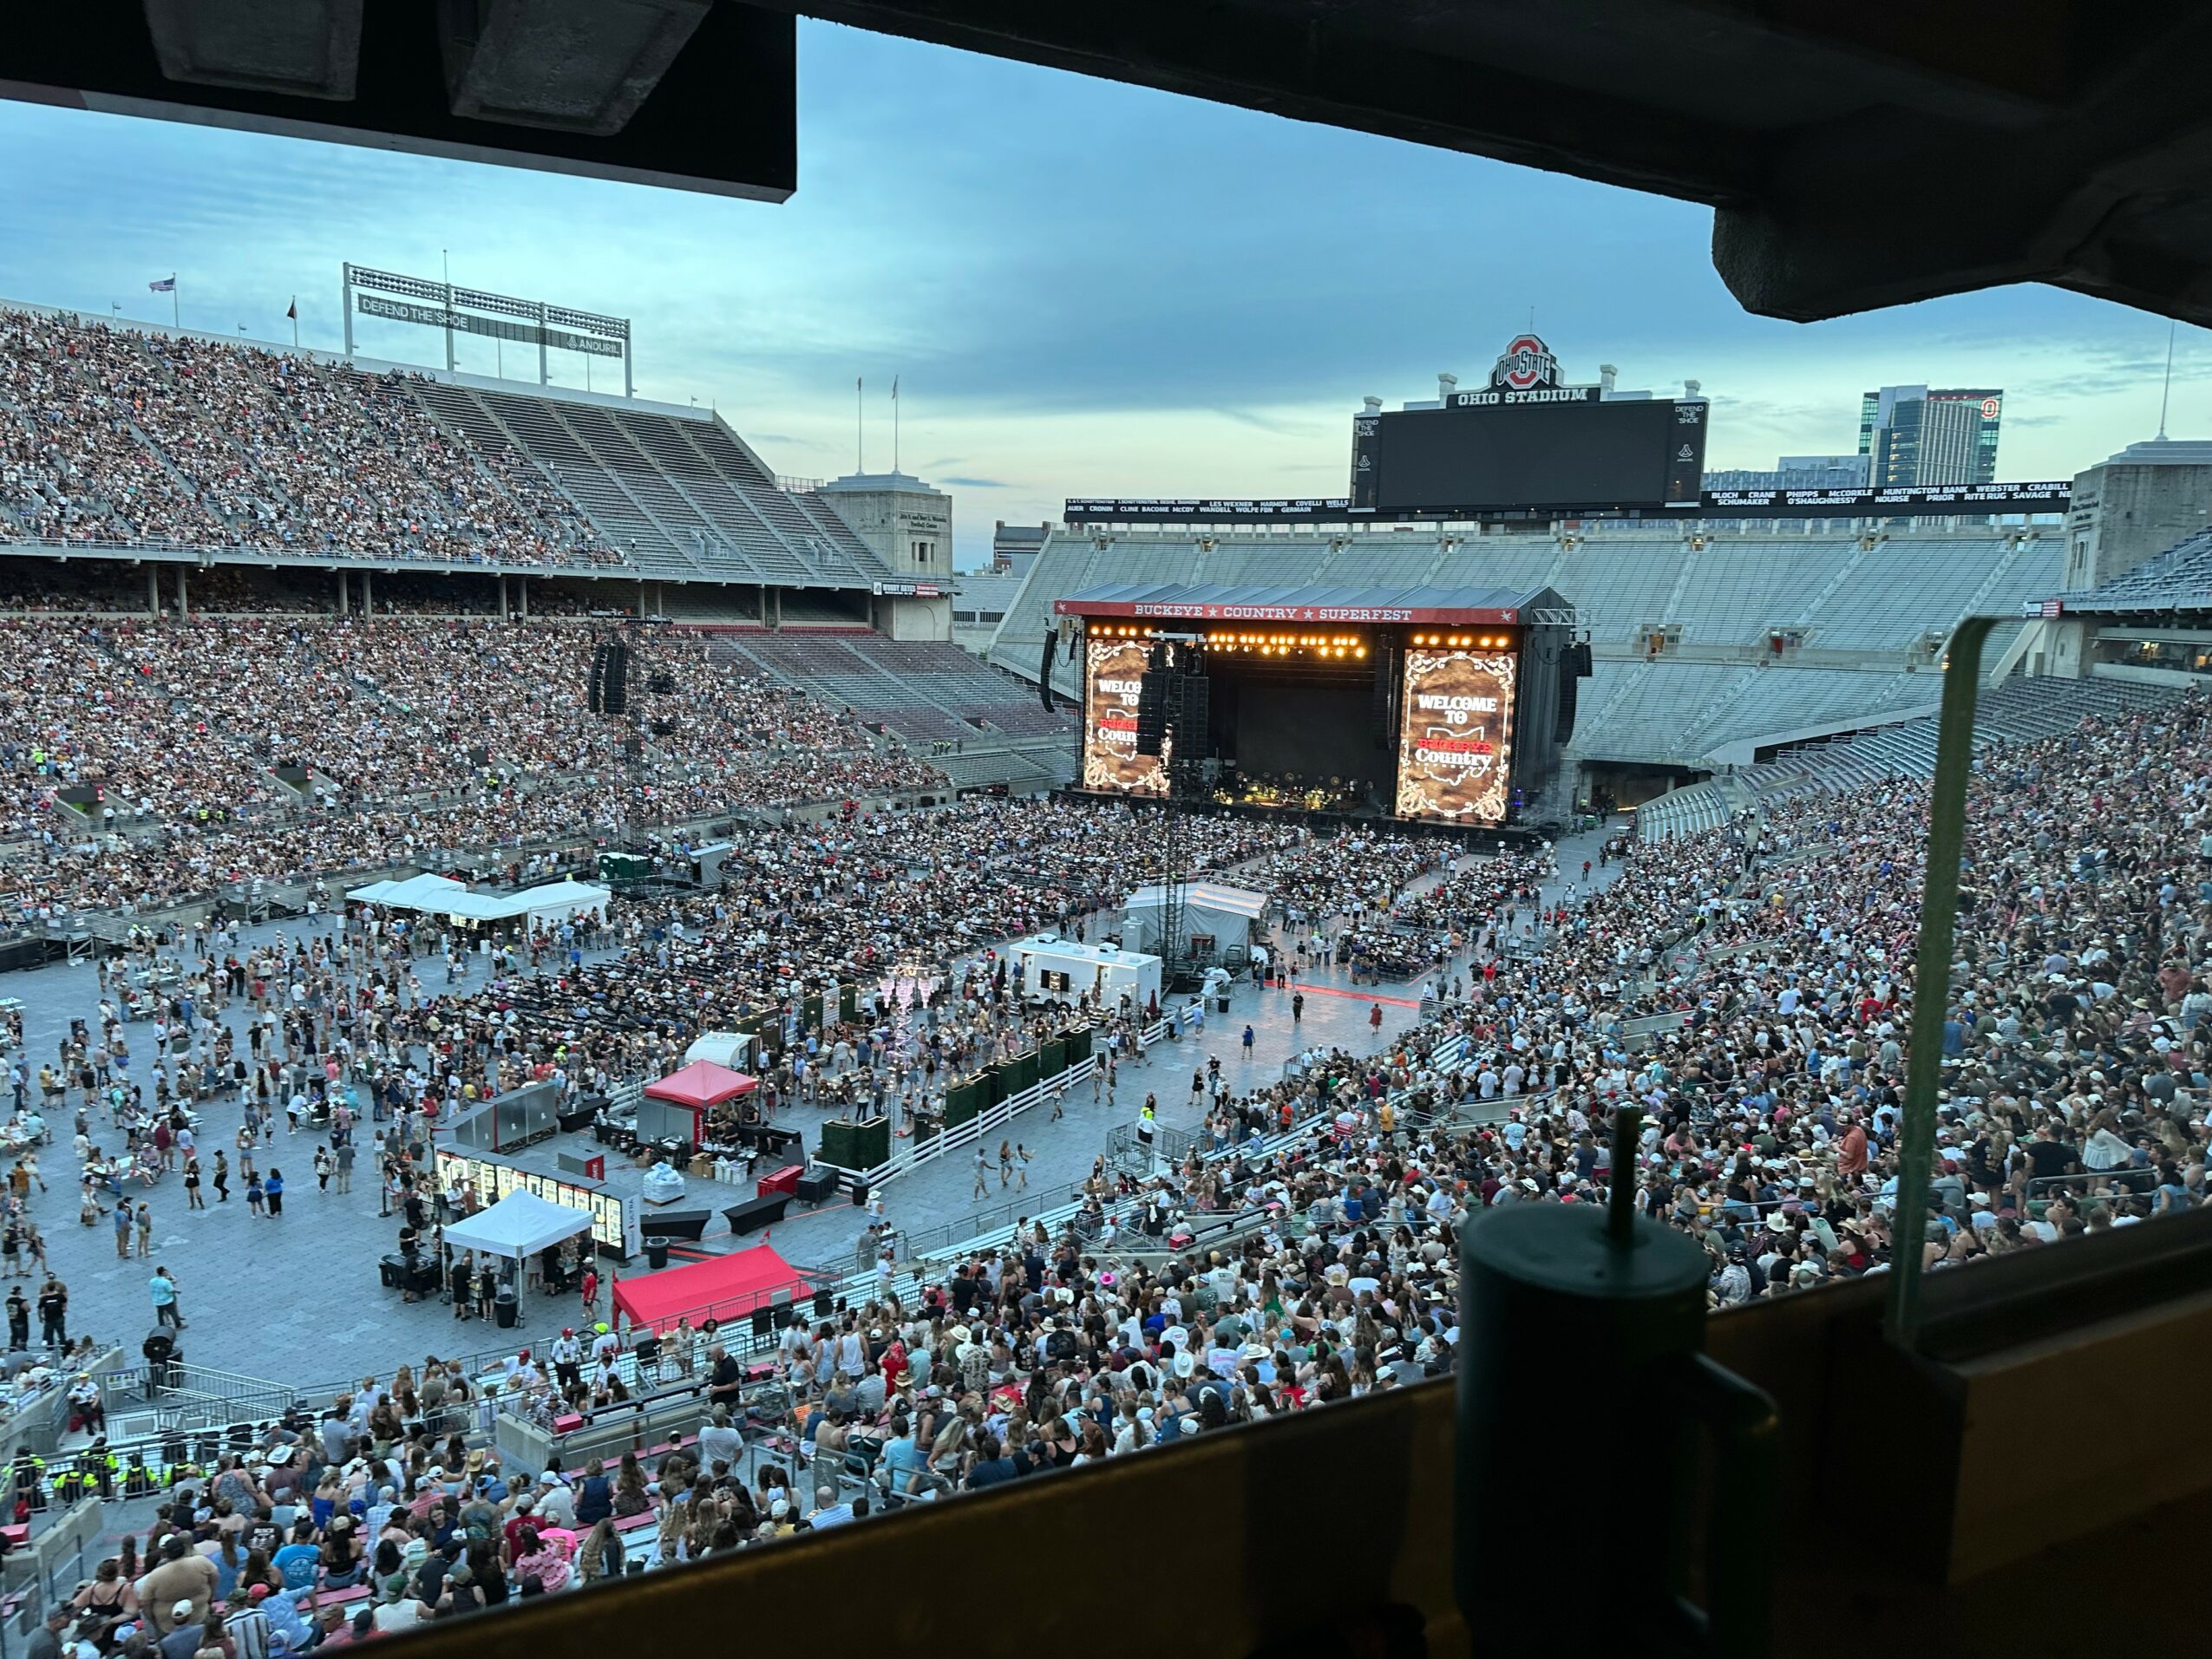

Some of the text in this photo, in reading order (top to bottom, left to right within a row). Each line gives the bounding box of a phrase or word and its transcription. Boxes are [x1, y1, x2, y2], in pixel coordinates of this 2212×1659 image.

[363, 298, 409, 317] DEFEND
[410, 308, 433, 322] THE
[579, 339, 619, 355] ANDURIL
[1497, 350, 1551, 384] OHIO STATE
[1457, 389, 1587, 406] OHIO STADIUM
[1787, 496, 1857, 505] O'SHAUGHNESSY
[1986, 491, 2006, 500] RUG
[1135, 604, 1412, 621] BUCKEYE COUNTRY SUPERFEST
[1098, 680, 1142, 695] WELCO
[1120, 693, 1139, 707] TO
[1417, 695, 1497, 712] WELCOME
[1444, 710, 1468, 724] TO
[1097, 727, 1137, 742] Coun
[1417, 739, 1493, 753] BUCKEYE
[1415, 748, 1493, 778] Country
